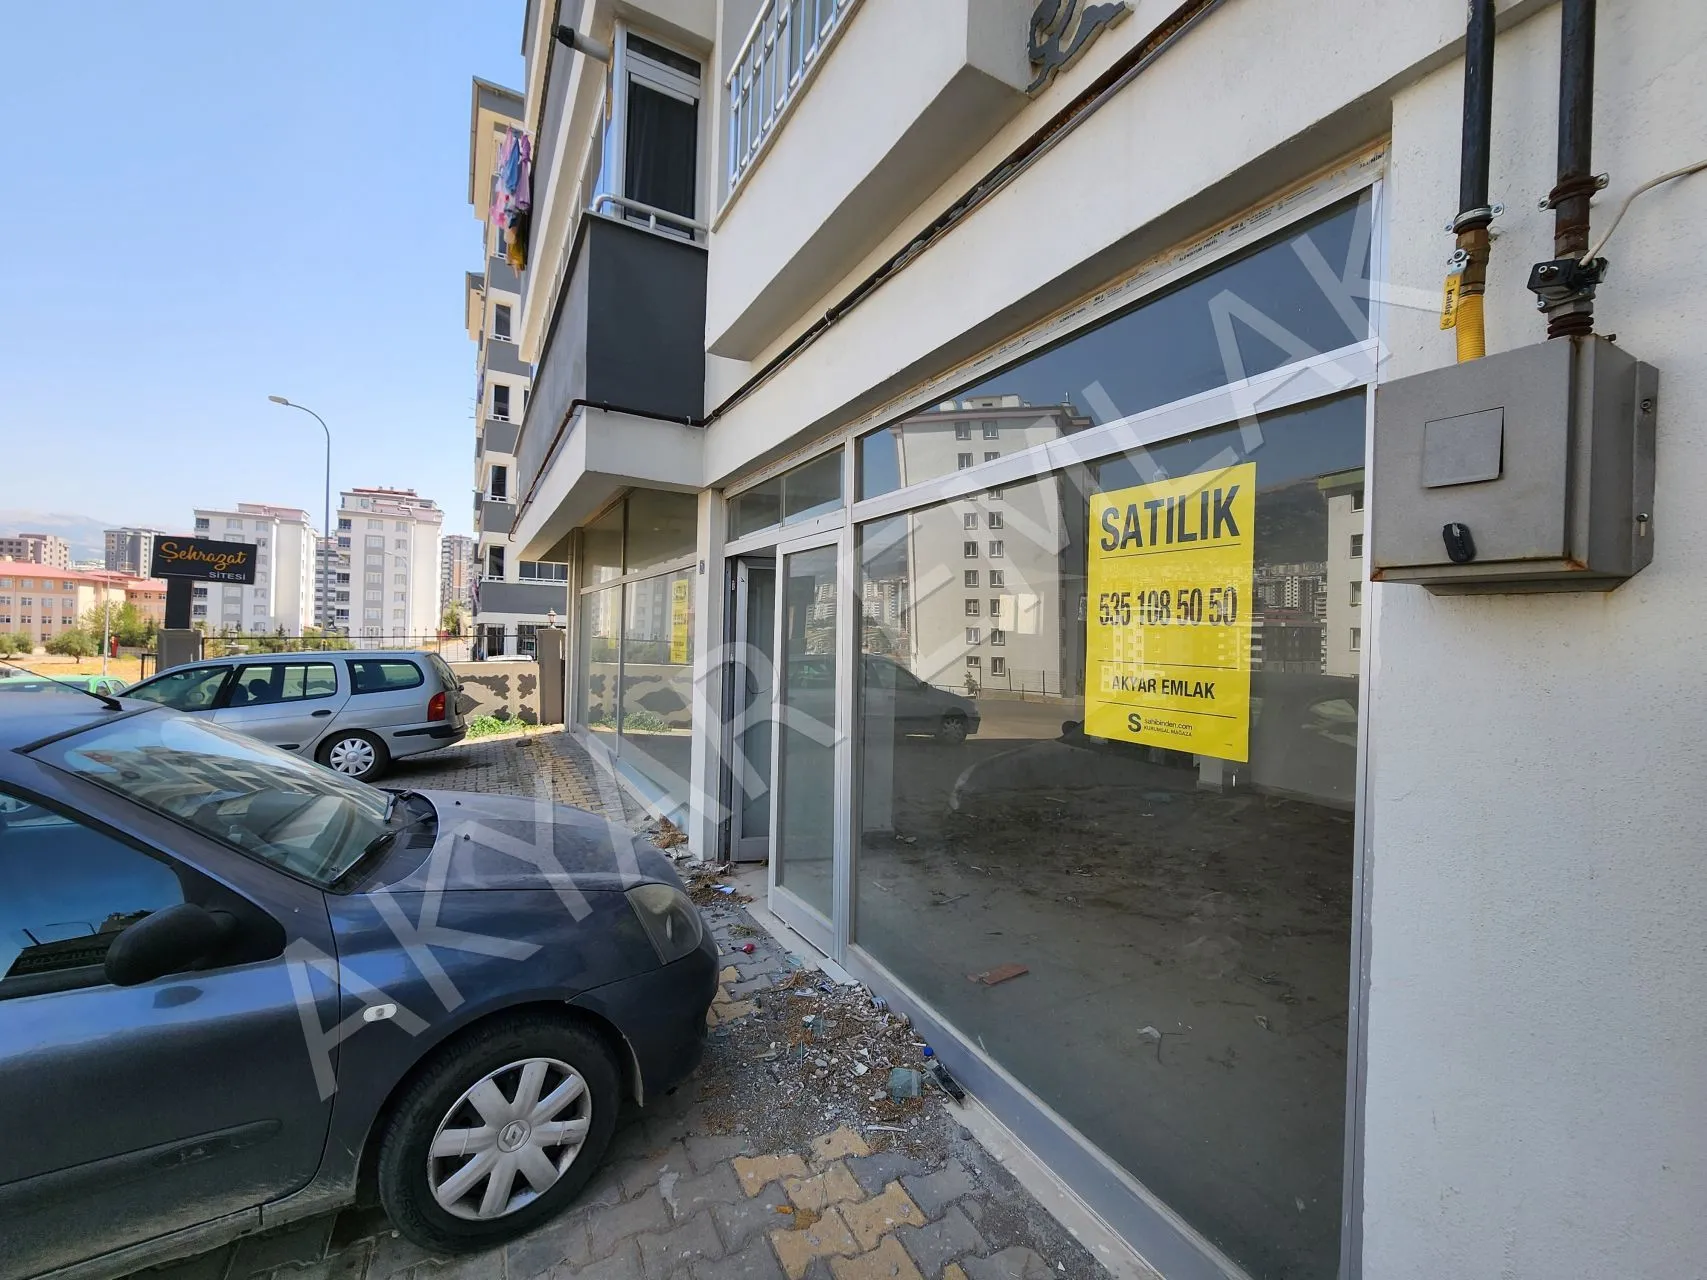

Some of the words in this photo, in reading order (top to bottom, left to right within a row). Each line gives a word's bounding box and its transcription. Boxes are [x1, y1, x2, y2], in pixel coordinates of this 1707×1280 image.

[1100, 485, 1240, 552] SATILIK
[160, 541, 248, 571] Şehrazat
[1099, 591, 1131, 626] 535
[1137, 589, 1171, 626] 108
[1176, 587, 1203, 626] 50
[1208, 586, 1238, 626] 50
[1112, 675, 1157, 694] AKYAR
[1161, 678, 1216, 700] EMLAK
